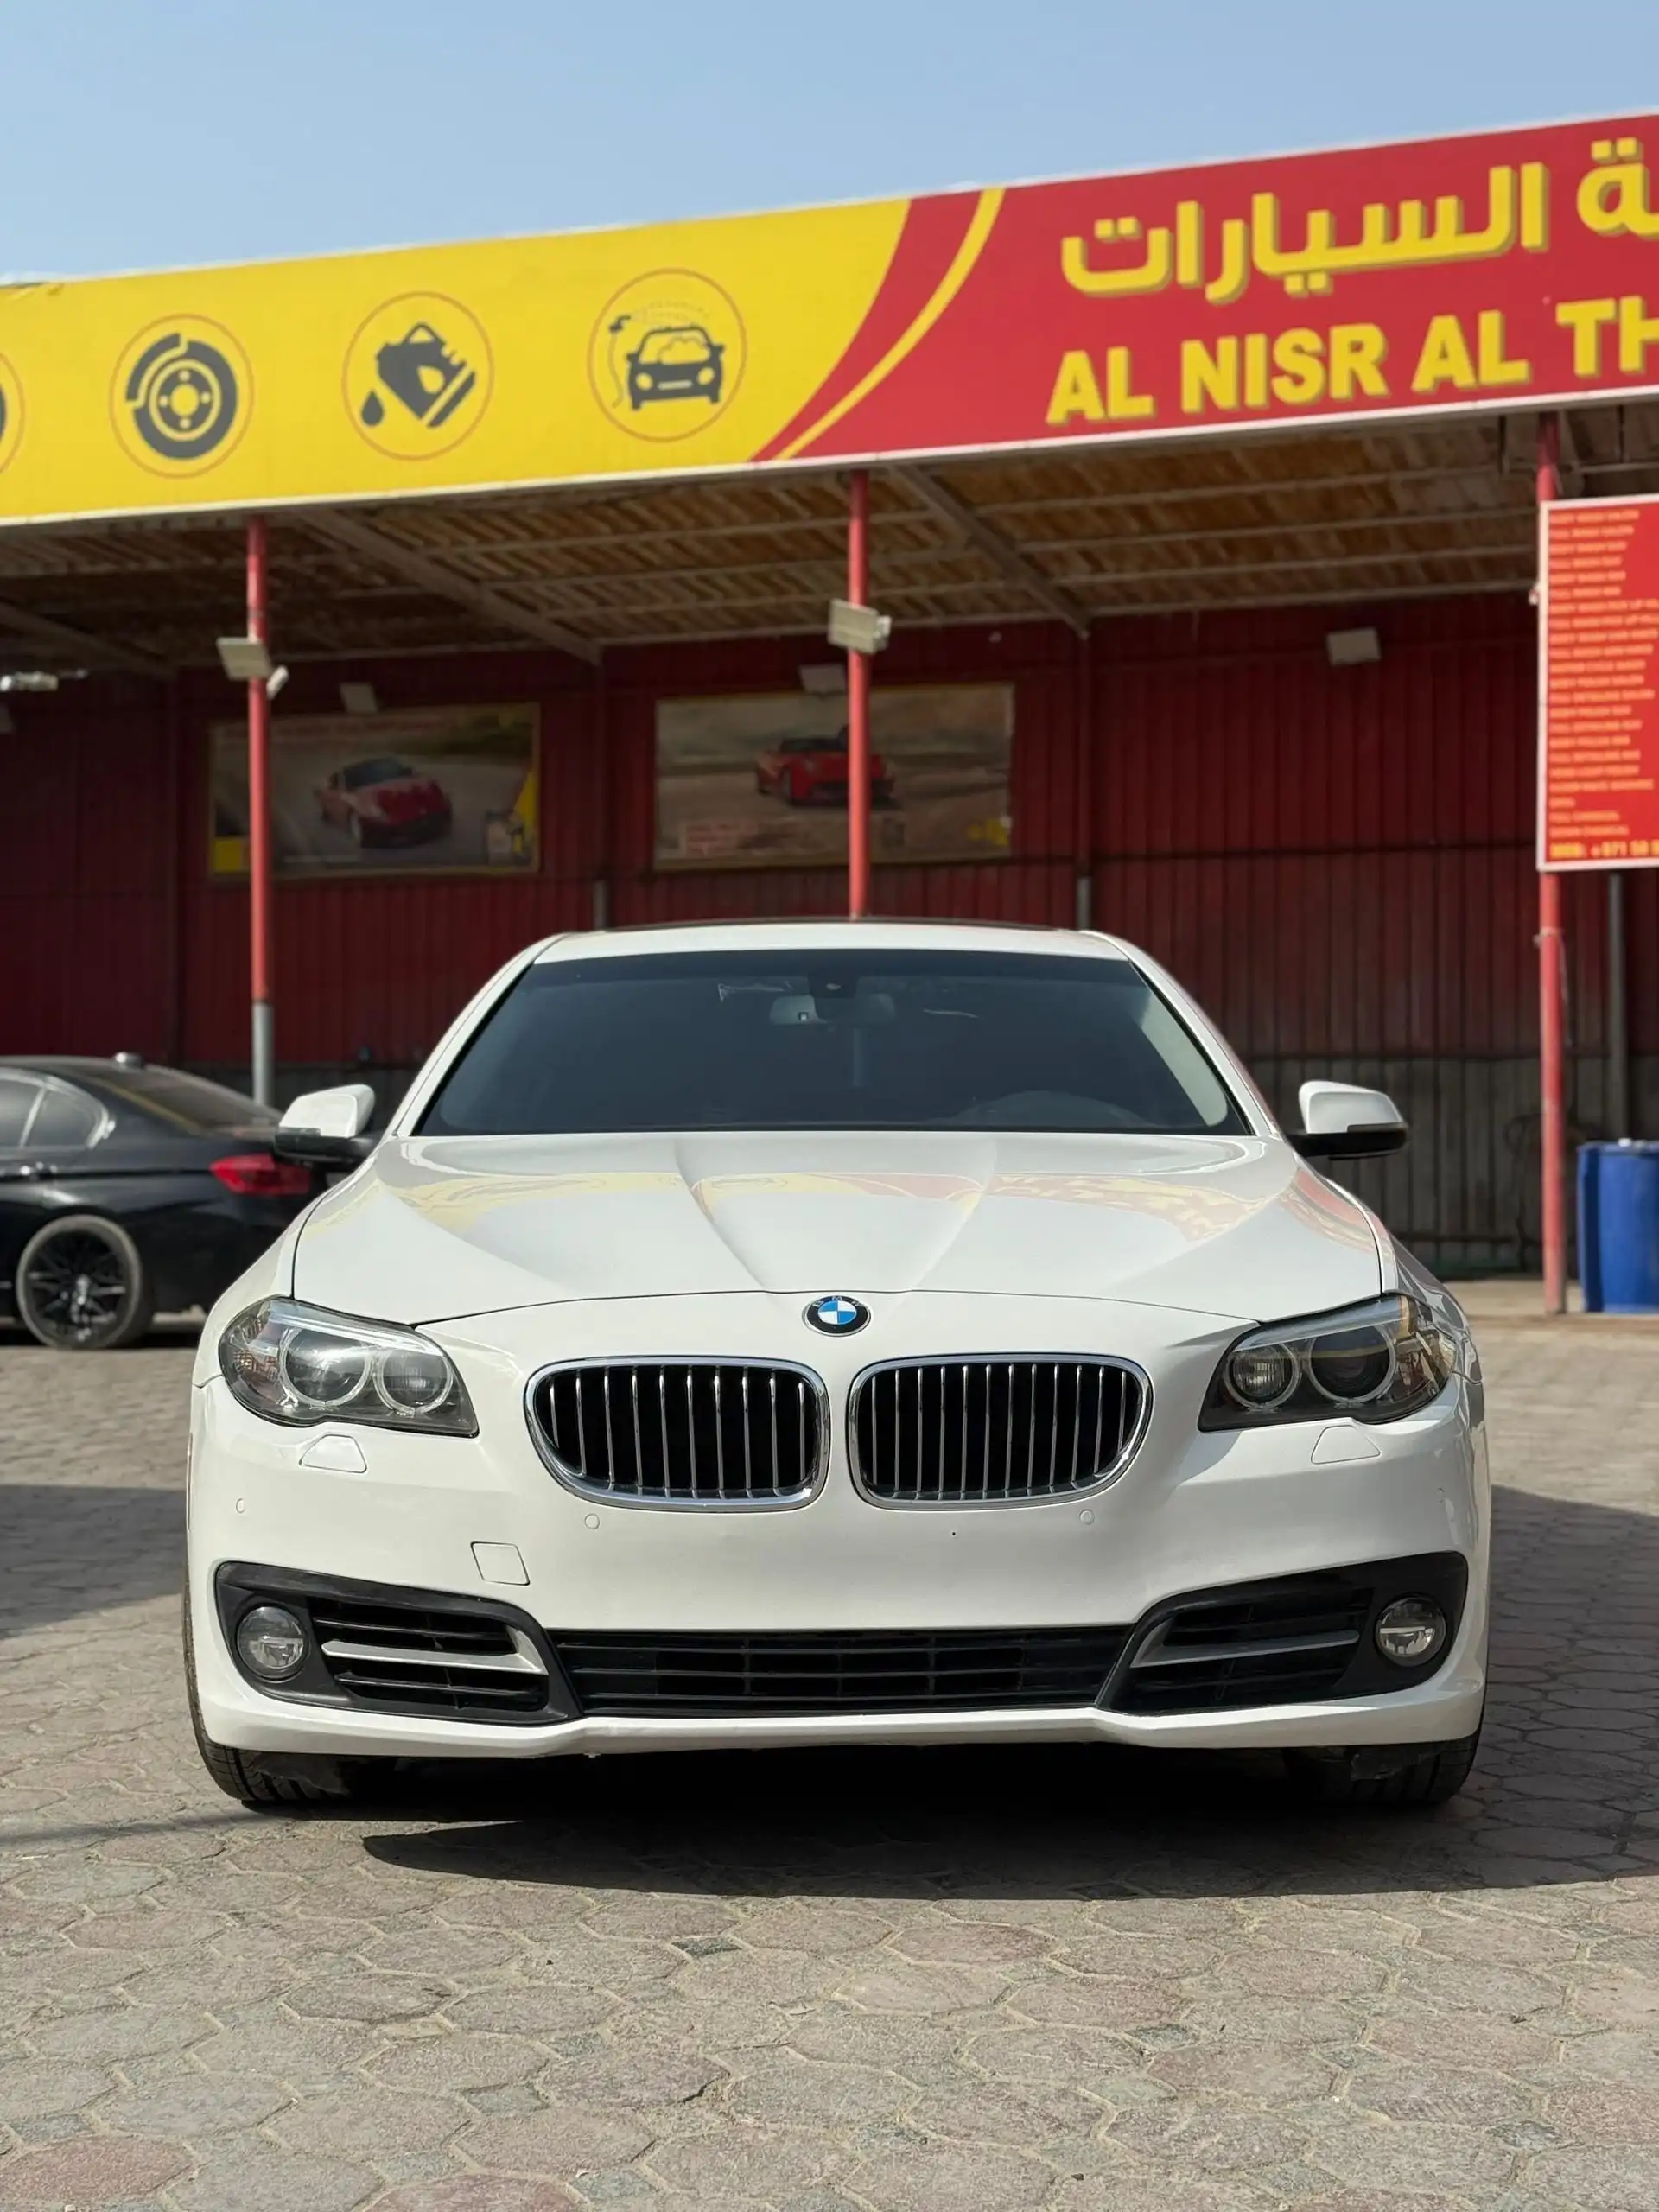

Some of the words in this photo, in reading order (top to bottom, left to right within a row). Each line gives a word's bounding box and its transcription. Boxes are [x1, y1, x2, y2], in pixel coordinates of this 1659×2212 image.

[1061, 162, 1551, 302] السيارات
[1576, 137, 1659, 237] ة
[1046, 346, 1155, 425] AL
[1181, 323, 1389, 414] NISR
[1411, 309, 1531, 392] AL
